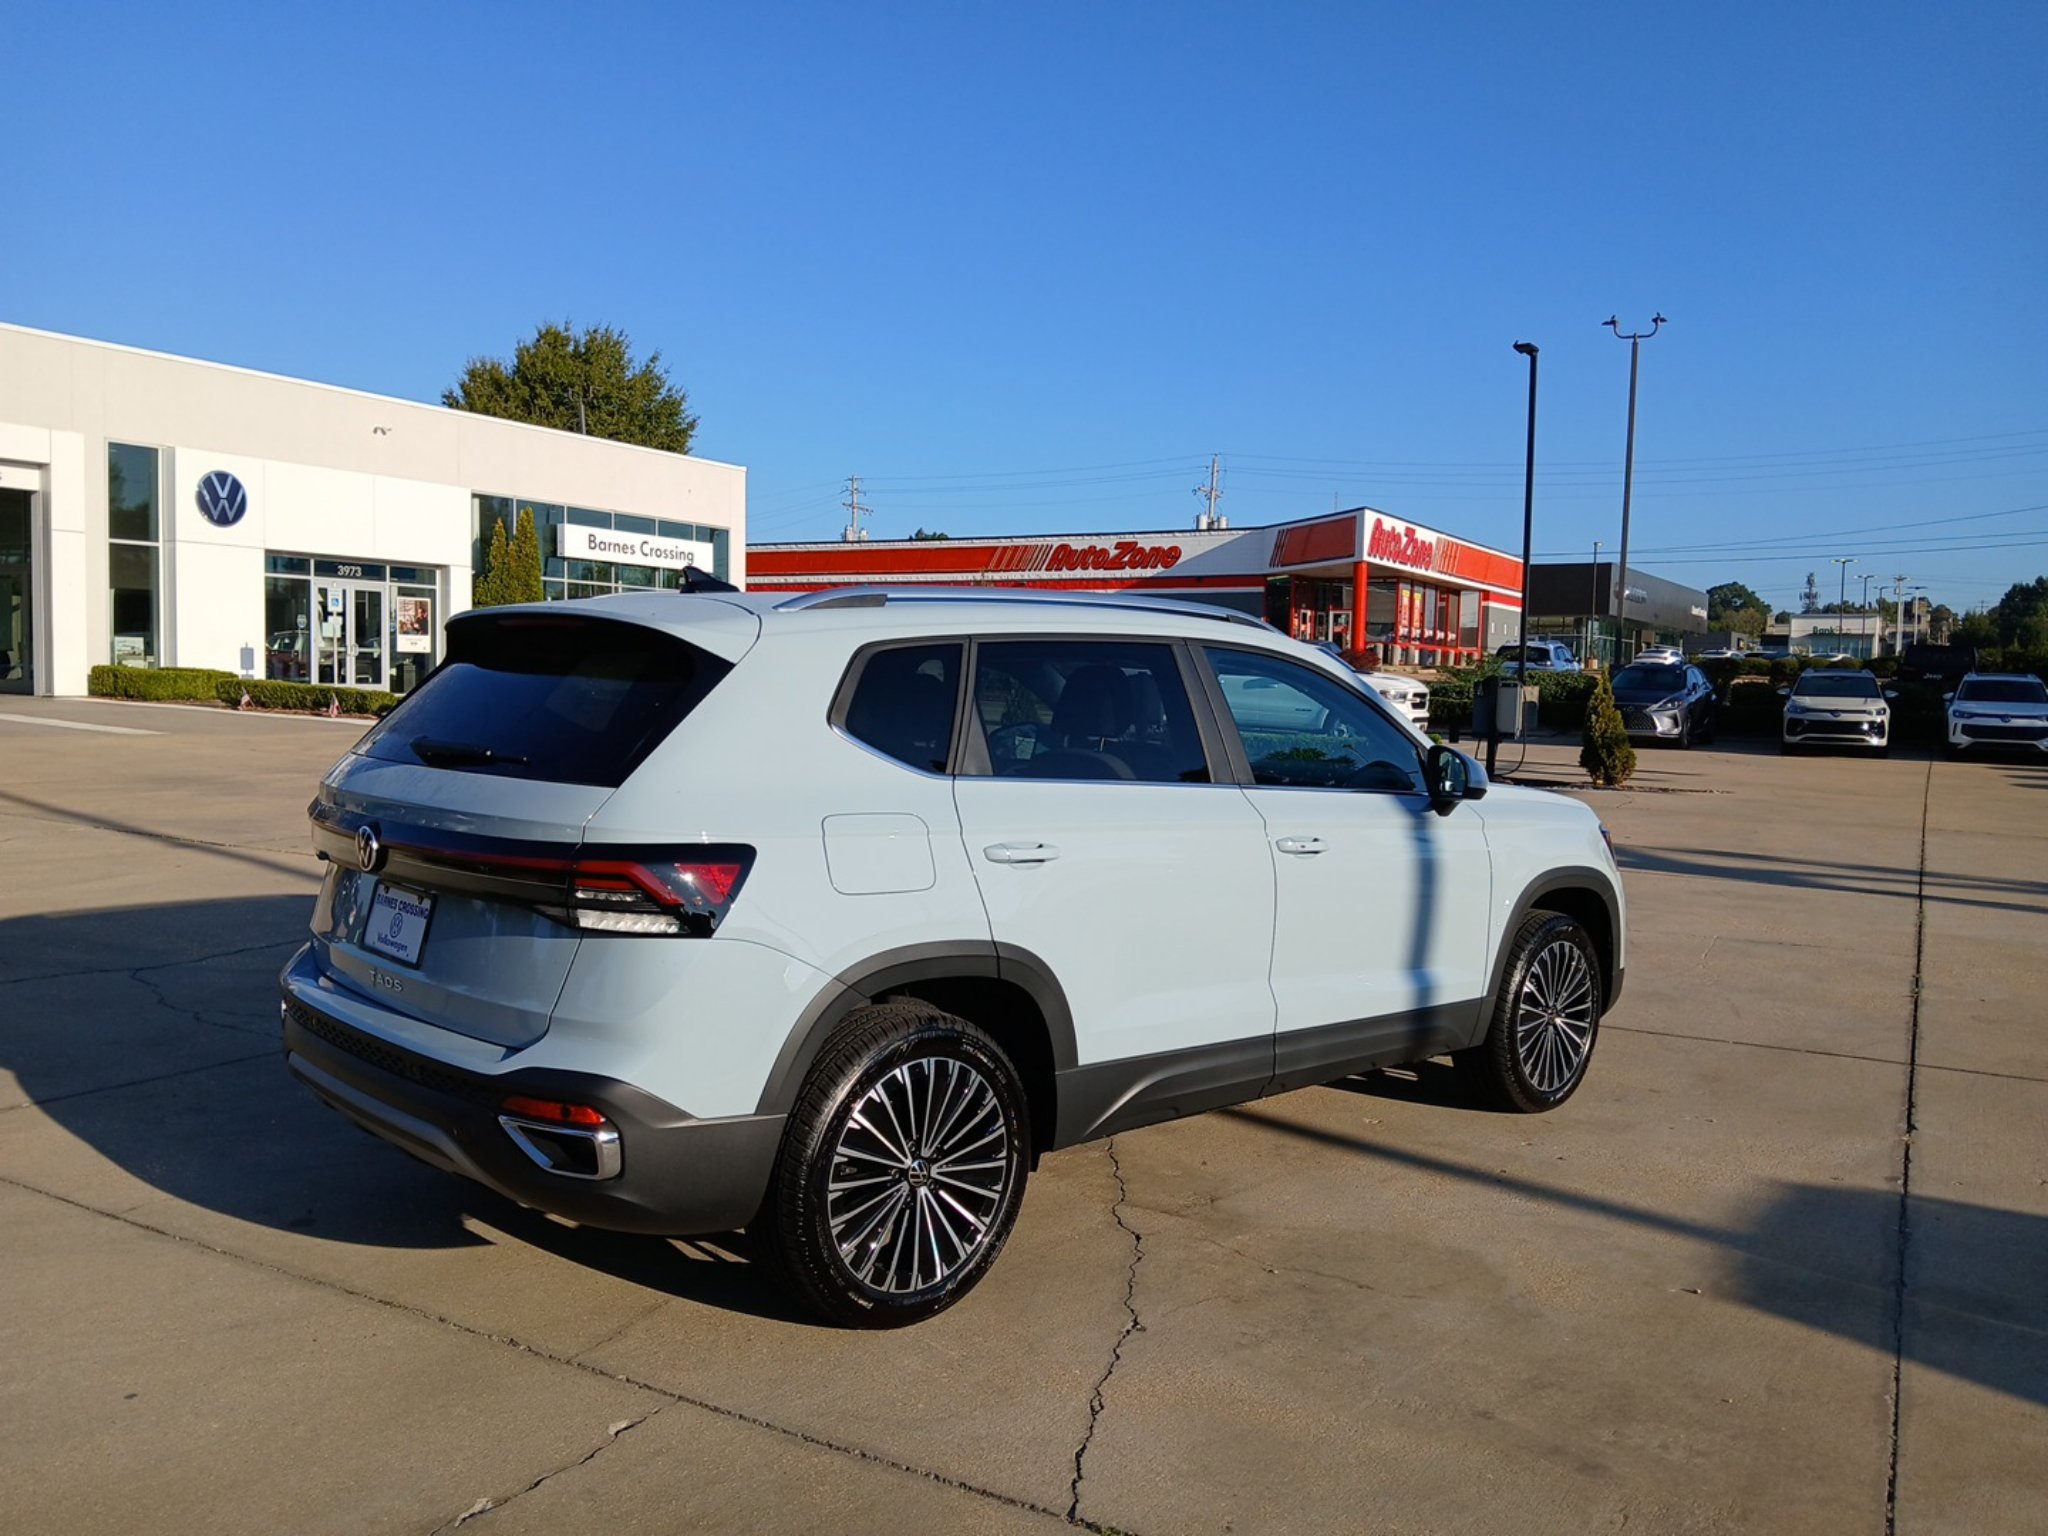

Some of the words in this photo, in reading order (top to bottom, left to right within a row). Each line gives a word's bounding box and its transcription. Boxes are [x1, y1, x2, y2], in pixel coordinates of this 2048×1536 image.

[588, 533, 636, 555] Barnes
[639, 540, 695, 565] Crossing
[1045, 541, 1182, 571] AutoZone
[1367, 517, 1433, 572] AutoZone
[337, 565, 362, 577] 3973
[375, 893, 399, 911] BARNES
[398, 900, 430, 920] CROSSING
[369, 970, 403, 991] TAOS
